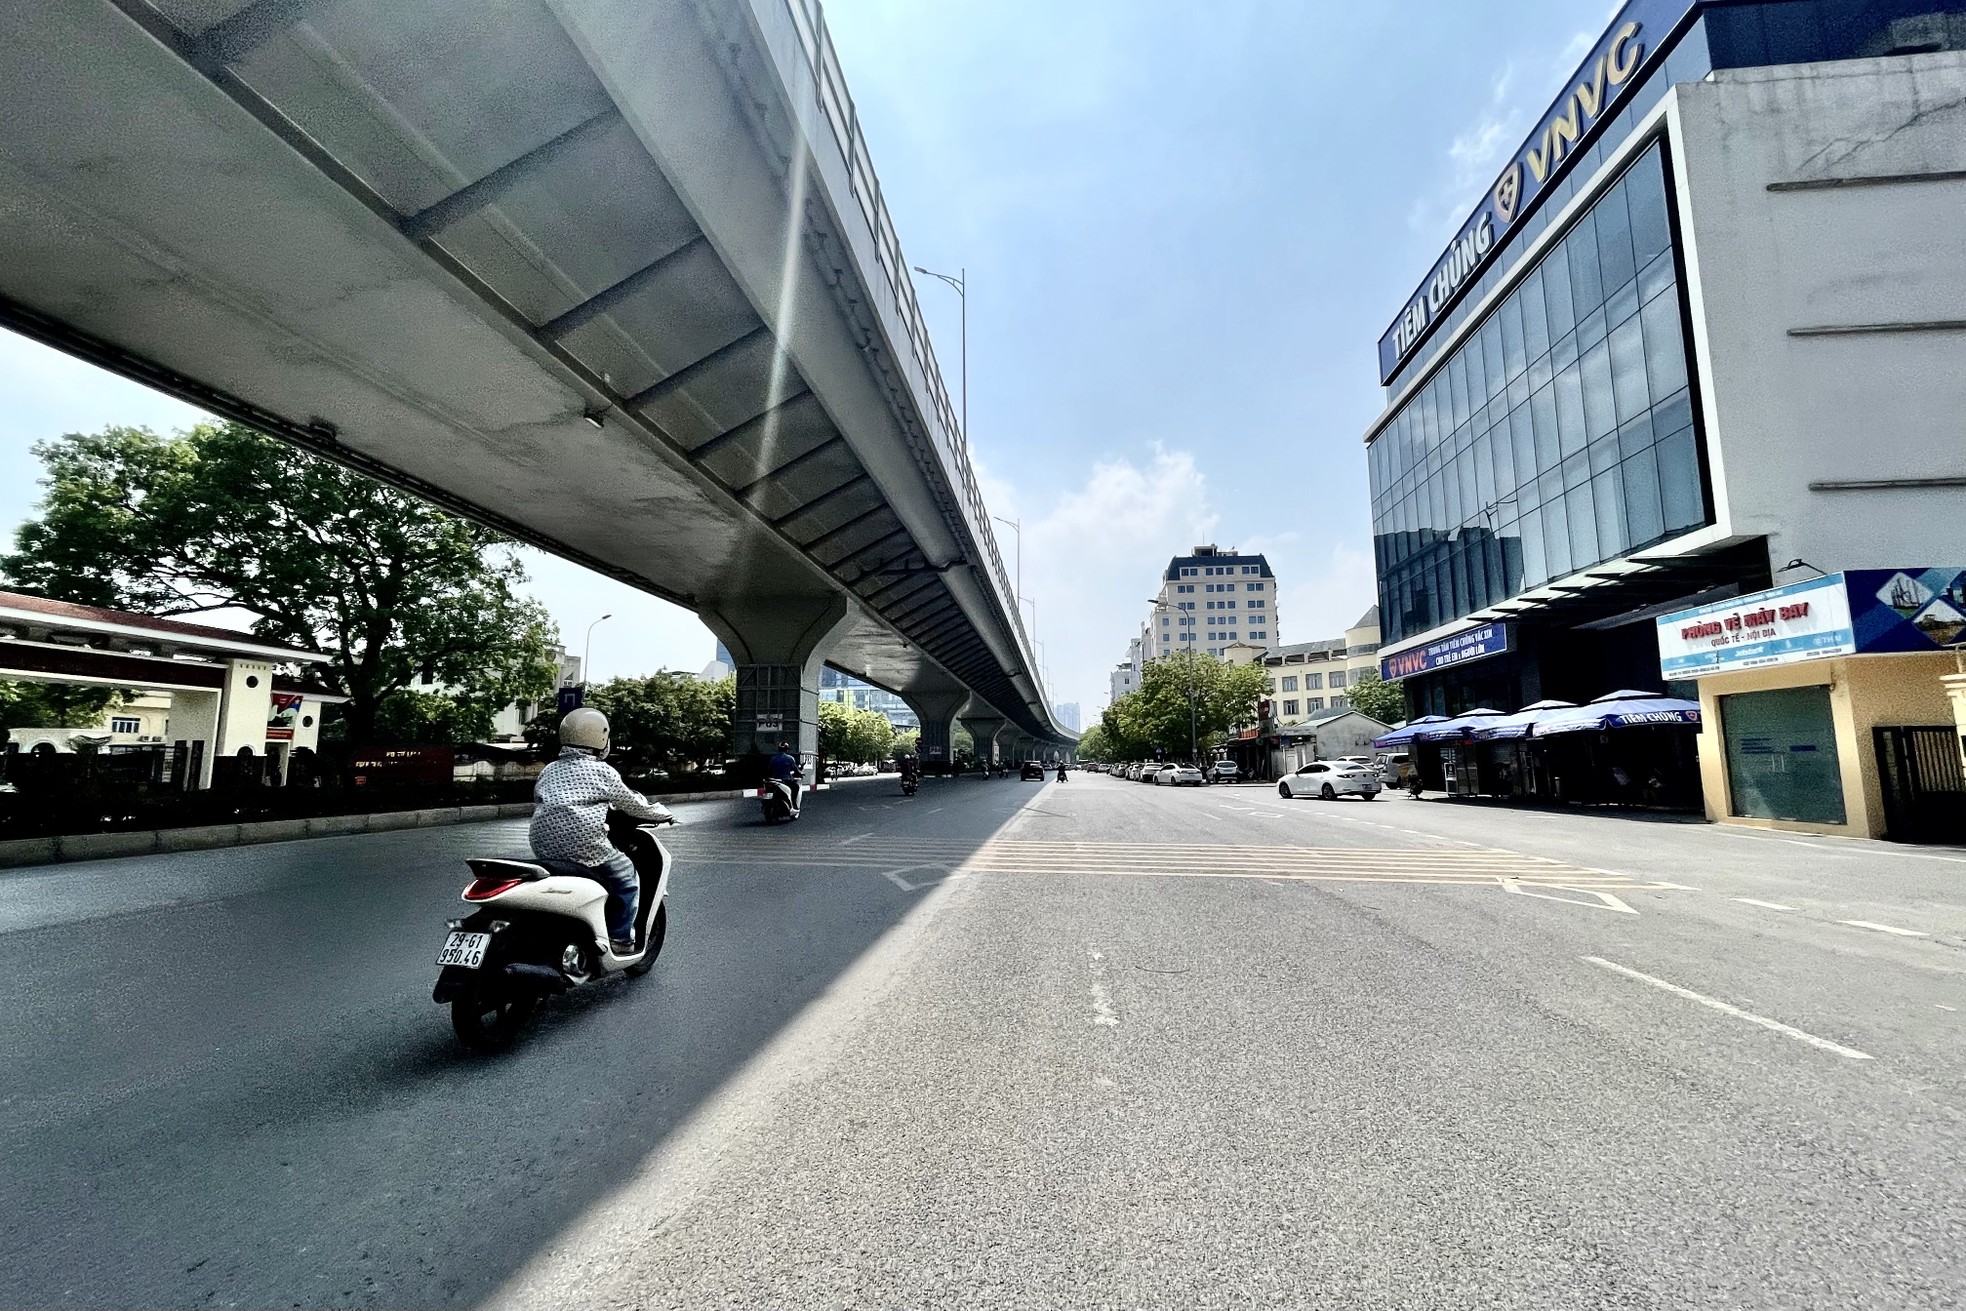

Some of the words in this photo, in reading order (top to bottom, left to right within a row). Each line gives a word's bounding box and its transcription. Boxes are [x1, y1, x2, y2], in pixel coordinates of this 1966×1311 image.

[1392, 296, 1428, 360] TIÊM
[1428, 211, 1494, 313] CHỦNG
[1526, 21, 1645, 183] VNVC
[1778, 602, 1809, 621] BAY
[1428, 647, 1441, 656] TRUNG
[1484, 628, 1493, 639] XIN
[1711, 635, 1730, 647] QUỐC
[1732, 632, 1740, 643] TẾ
[1747, 629, 1760, 641] NỘI
[1762, 627, 1777, 639] ĐỊA
[1398, 650, 1427, 675] VNVC
[1435, 655, 1444, 666] CHO
[450, 933, 484, 949] 29-G1
[440, 949, 481, 965] 950.46
